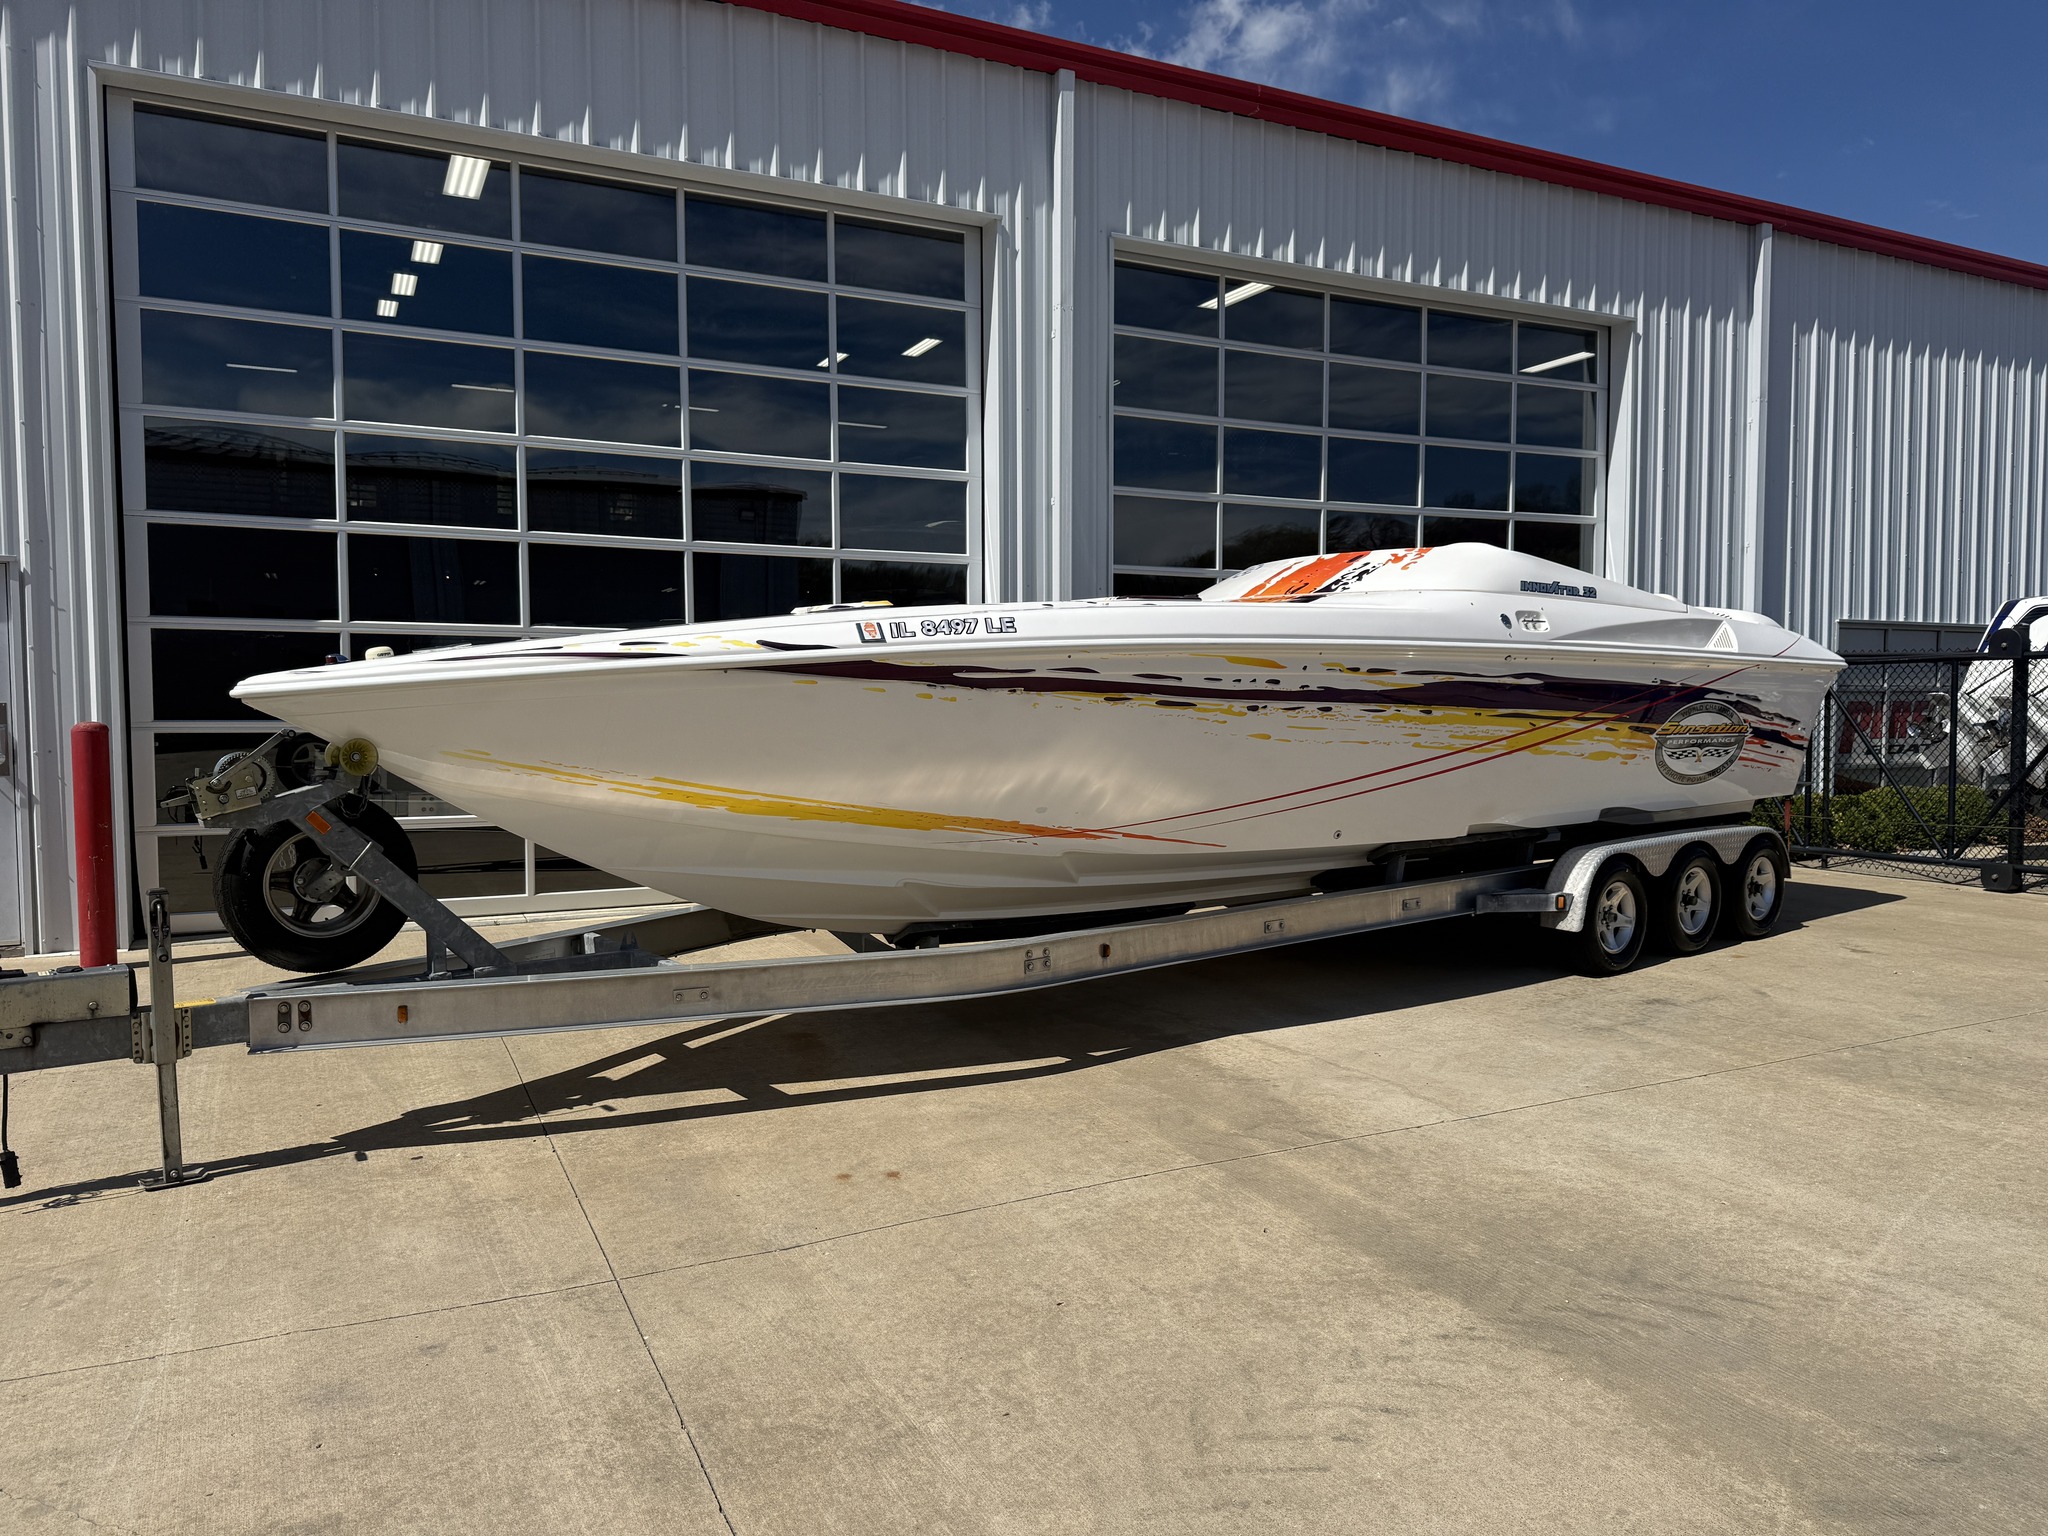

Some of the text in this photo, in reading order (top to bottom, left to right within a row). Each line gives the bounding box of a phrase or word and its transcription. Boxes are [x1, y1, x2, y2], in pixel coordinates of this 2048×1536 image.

[1582, 586, 1597, 598] 32
[889, 617, 1017, 638] IL 8497 LE
[1681, 704, 1704, 717] WORLD
[1656, 721, 1748, 736] Sunsation
[1667, 737, 1735, 745] PERFORMANCE
